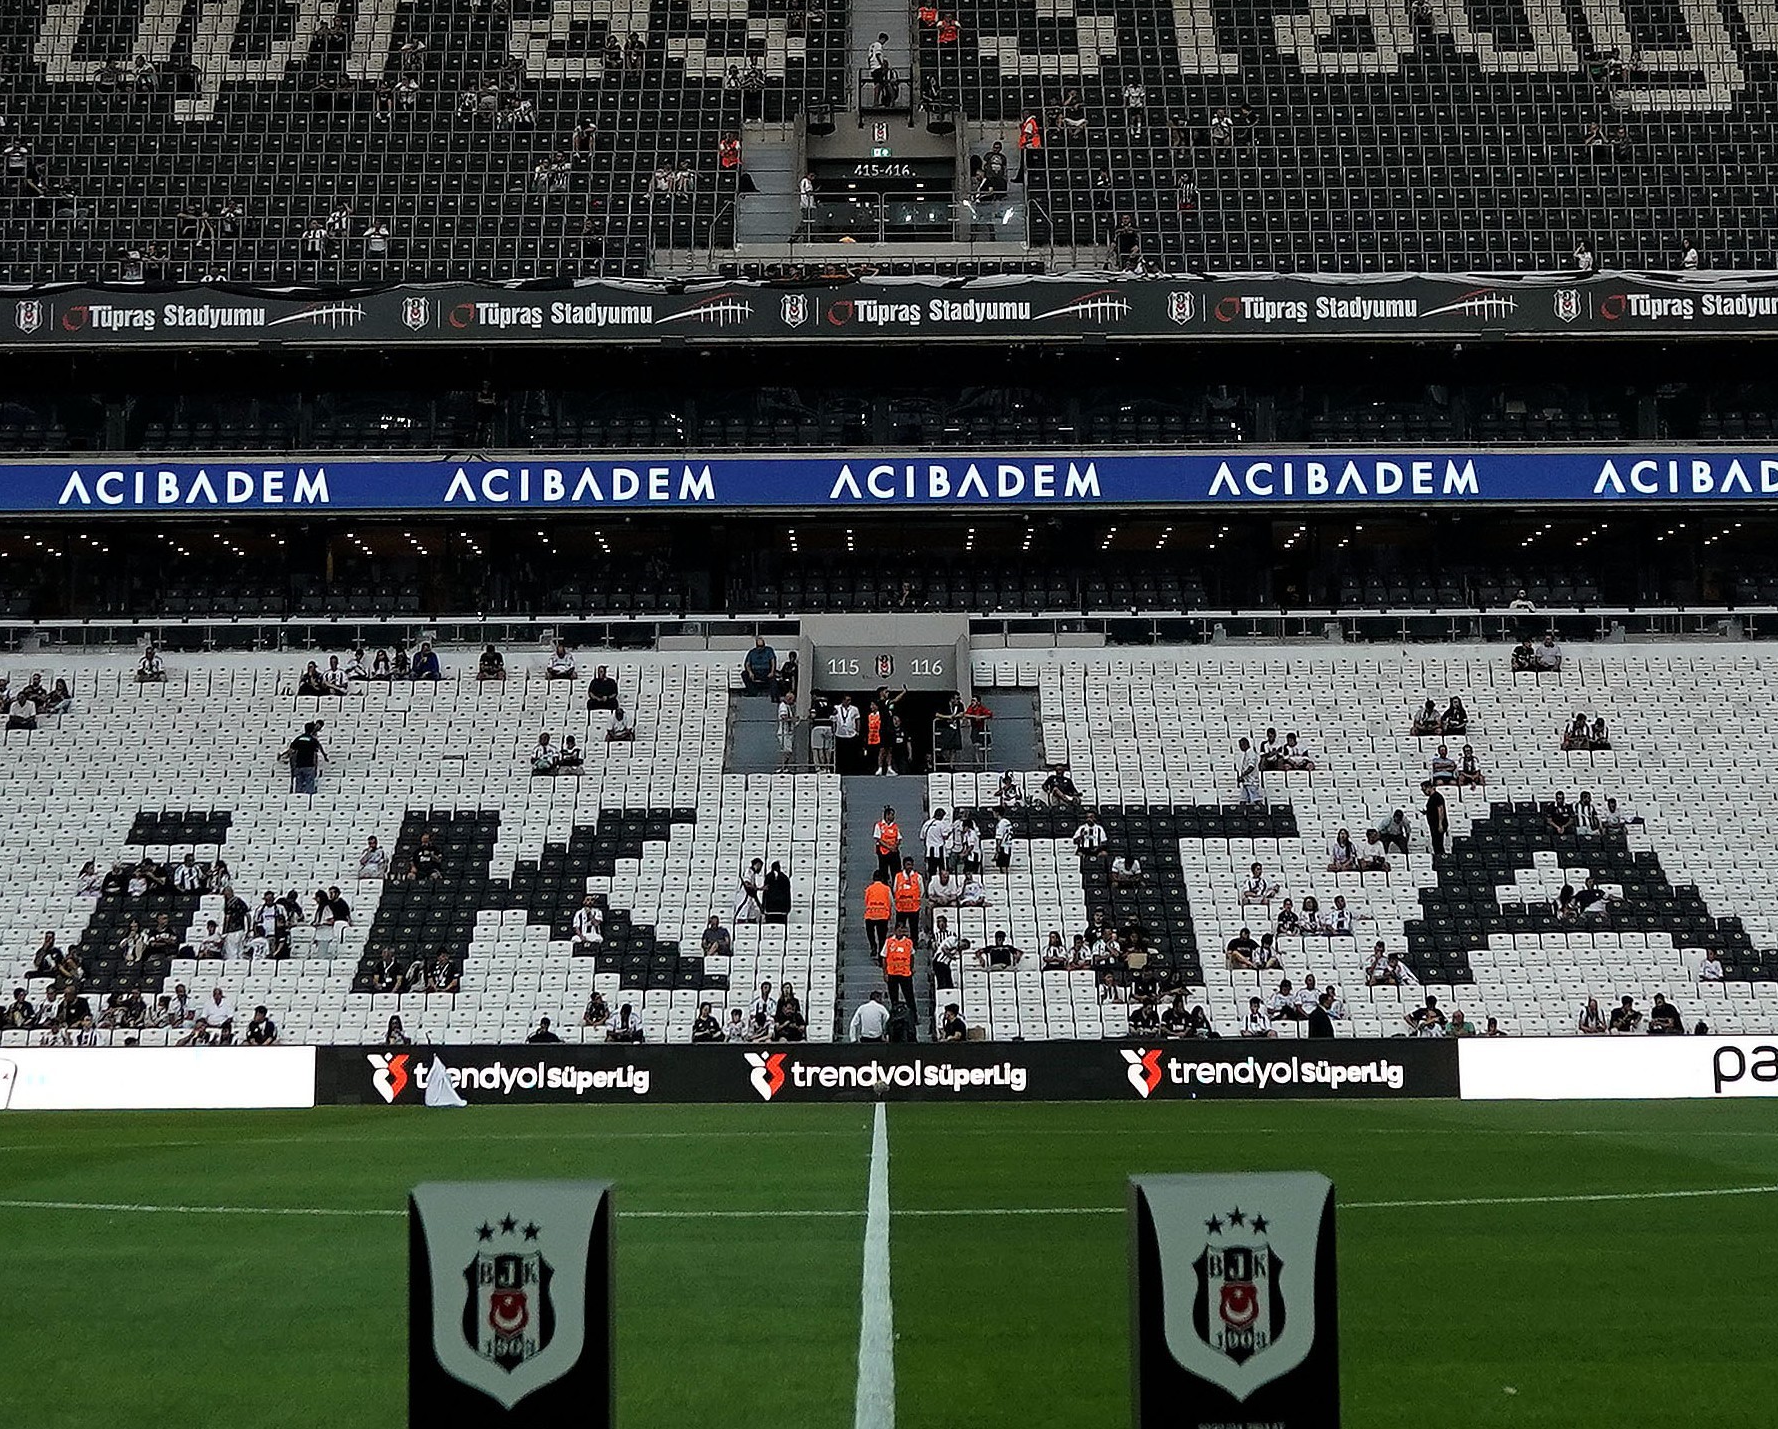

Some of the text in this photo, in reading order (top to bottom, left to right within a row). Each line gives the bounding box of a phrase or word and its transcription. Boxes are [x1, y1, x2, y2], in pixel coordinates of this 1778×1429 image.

[88, 304, 265, 331] Tüpraş Stadyumu
[476, 302, 653, 328] Tüpraş Stadyumu
[854, 299, 1031, 325] Tüpraş Stadyumu
[1240, 295, 1417, 322] Tüpraş Stadyumu
[1626, 294, 1694, 320] Tüpraş
[59, 468, 329, 504] ACIBADEM
[444, 465, 714, 501] ACIBADEM
[830, 463, 1100, 498] ACIBADEM
[1209, 460, 1478, 495] ACIBADEM
[827, 658, 943, 676] 115 116
[413, 1061, 545, 1095] tendyol
[790, 1059, 921, 1089] trendyol
[1167, 1056, 1299, 1089] trendyol
[479, 1259, 539, 1286] BJK
[1209, 1251, 1269, 1279] BJK
